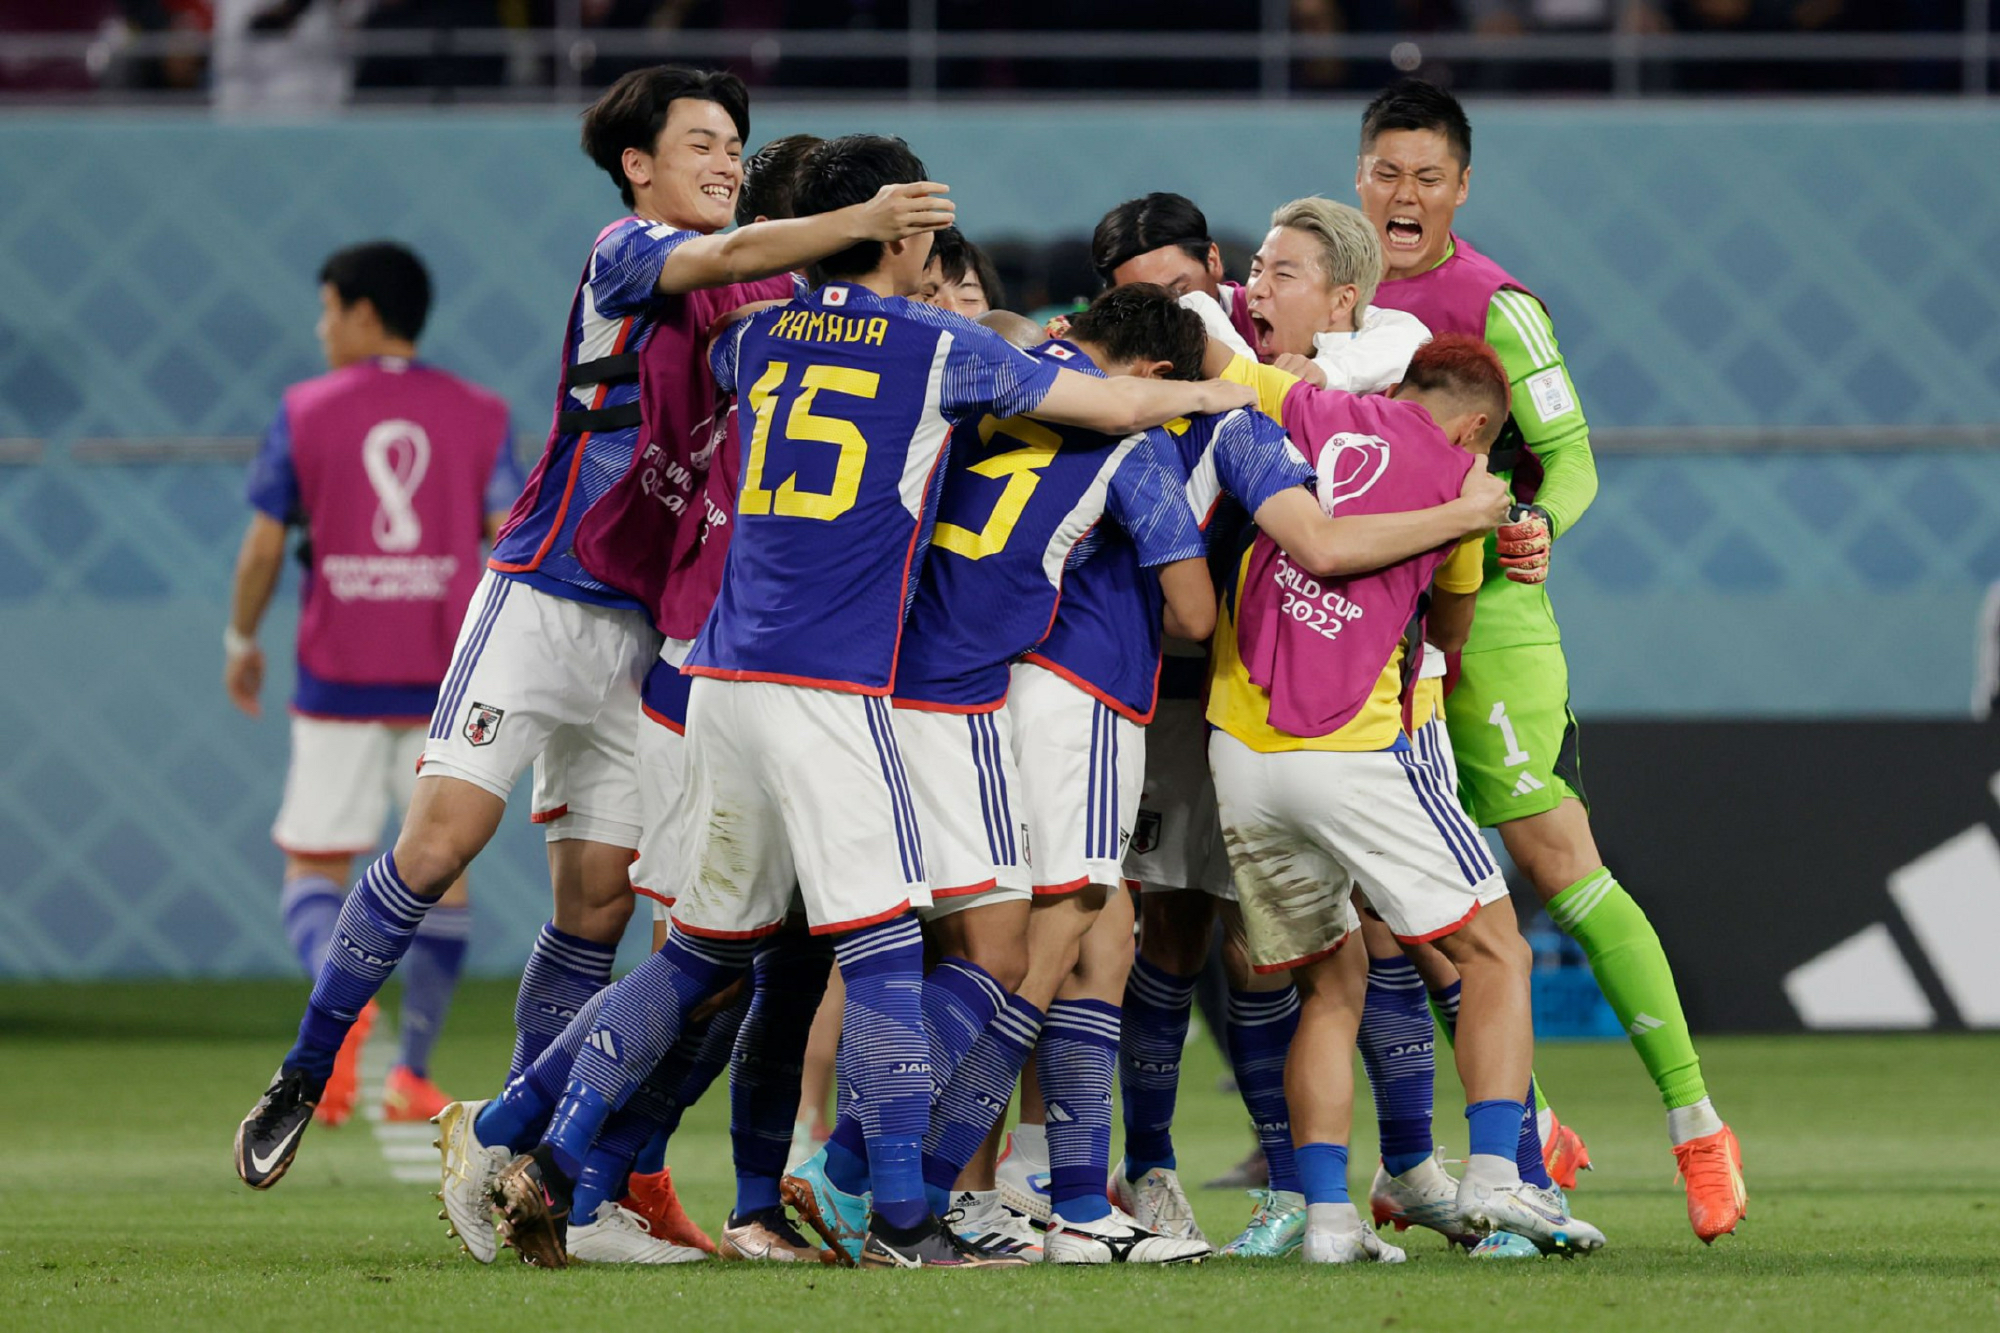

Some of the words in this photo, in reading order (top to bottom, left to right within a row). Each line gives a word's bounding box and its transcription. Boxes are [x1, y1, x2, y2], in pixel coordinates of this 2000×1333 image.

[768, 310, 889, 346] KAMADA
[738, 361, 880, 521] 15
[1281, 592, 1342, 640] 2022
[1322, 592, 1363, 622] CUP
[1488, 701, 1530, 767] 1
[1390, 1041, 1434, 1057] JAP
[893, 1063, 931, 1074] JAP
